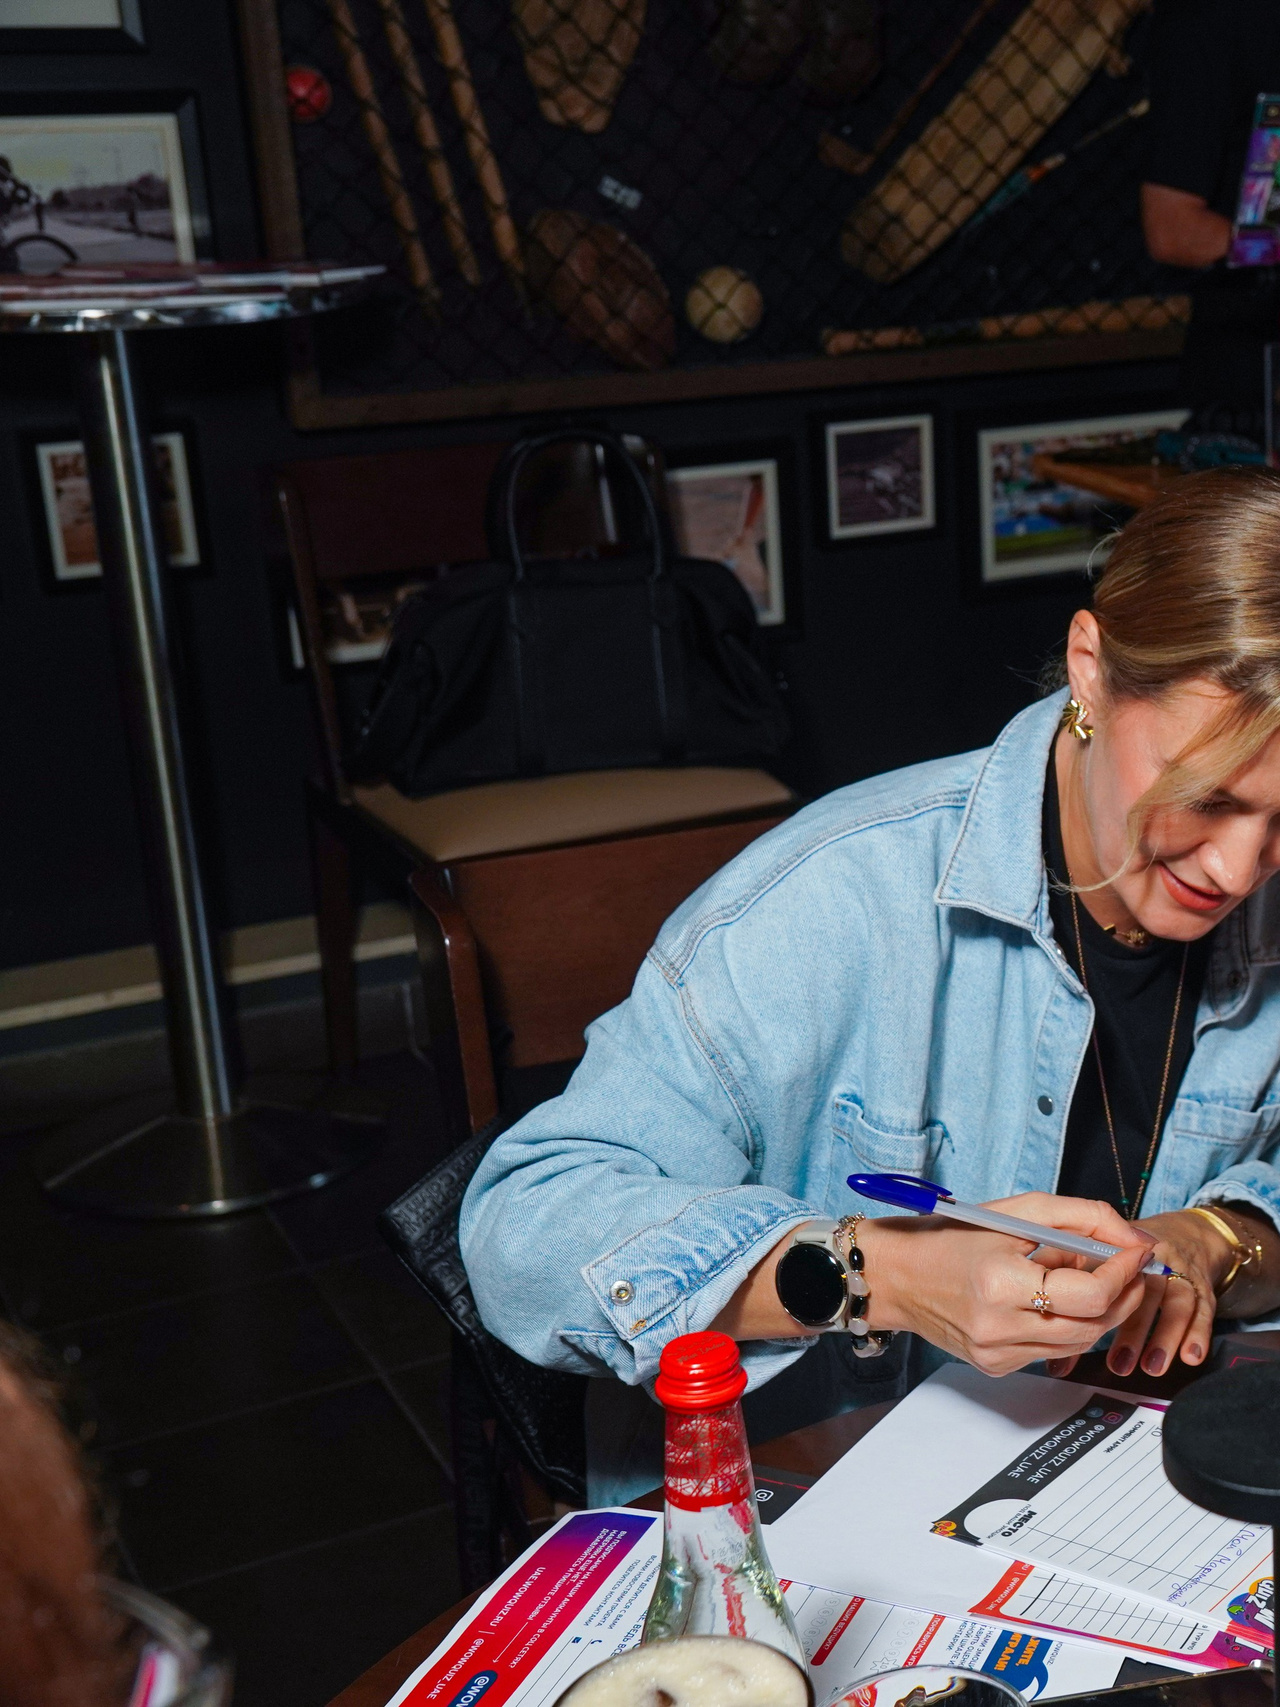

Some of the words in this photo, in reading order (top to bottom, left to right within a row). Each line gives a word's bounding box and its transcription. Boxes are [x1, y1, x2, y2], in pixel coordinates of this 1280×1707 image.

[1006, 1420, 1086, 1478] @WOWQUIZ_UAE
[1025, 1425, 1105, 1483] @WOWQUIZ_UAE
[1000, 1510, 1036, 1538] МЕСТО
[571, 1527, 609, 1567] ДОБАВЛЯЙТЕСЬ
[588, 1529, 617, 1558] НАВЕРНЯКА
[588, 1538, 619, 1571] ПОДПИСАНЫ
[580, 1571, 591, 1580] НА
[611, 1558, 640, 1590] ПОДЕЛИТЕСЬ
[640, 1554, 657, 1571] ВСЕМИ
[489, 1566, 545, 1626] UAE.WOWQUIZ.RU
[546, 1572, 570, 1596] ПИШИТЕ
[566, 1579, 584, 1597] НАШИ
[616, 1571, 642, 1601] НОВОСТЯМИ
[623, 1582, 646, 1609] ДЕЛИТЬСЯ
[526, 1595, 550, 1620] ОТЗЫВЫ
[541, 1597, 569, 1629] АККАУНТЫ
[583, 1590, 614, 1626] КОНТАКТАМИ
[607, 1614, 622, 1629] ВАМИ
[841, 1602, 857, 1620] НАШИХ
[524, 1633, 540, 1646] СОЦ
[912, 1618, 940, 1654] ПОНРАВИЛАСЬ
[426, 1638, 484, 1699] @WOWQUIZ_UAE
[508, 1646, 529, 1668] СЕТЯХ?
